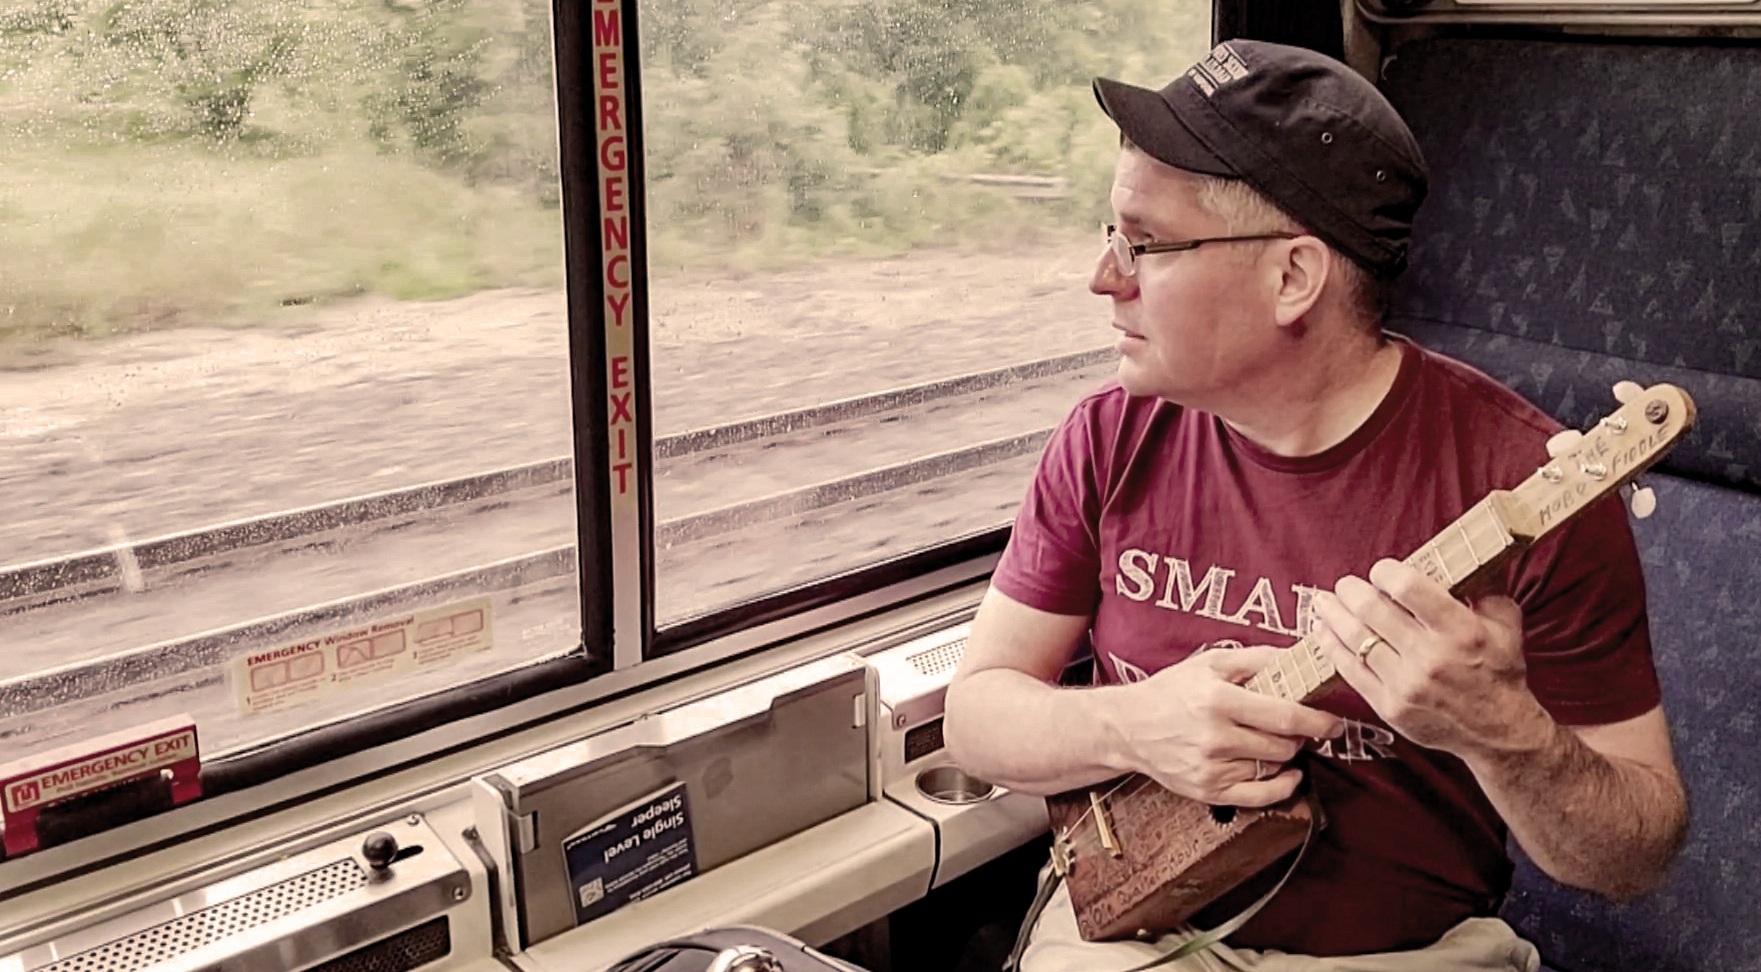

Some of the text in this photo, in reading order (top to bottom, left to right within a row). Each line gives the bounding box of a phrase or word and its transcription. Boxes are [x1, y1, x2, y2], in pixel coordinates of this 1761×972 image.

[594, 0, 632, 494] MERGENCY EXIT
[1612, 423, 1670, 475] FIDDLE
[247, 615, 415, 666] EMERGENCY Window Removal
[41, 747, 149, 790] EMERGENCY
[154, 734, 191, 756] EXIT
[631, 794, 682, 828] Sleeper
[642, 812, 684, 839] Single
[603, 834, 640, 864] Level
